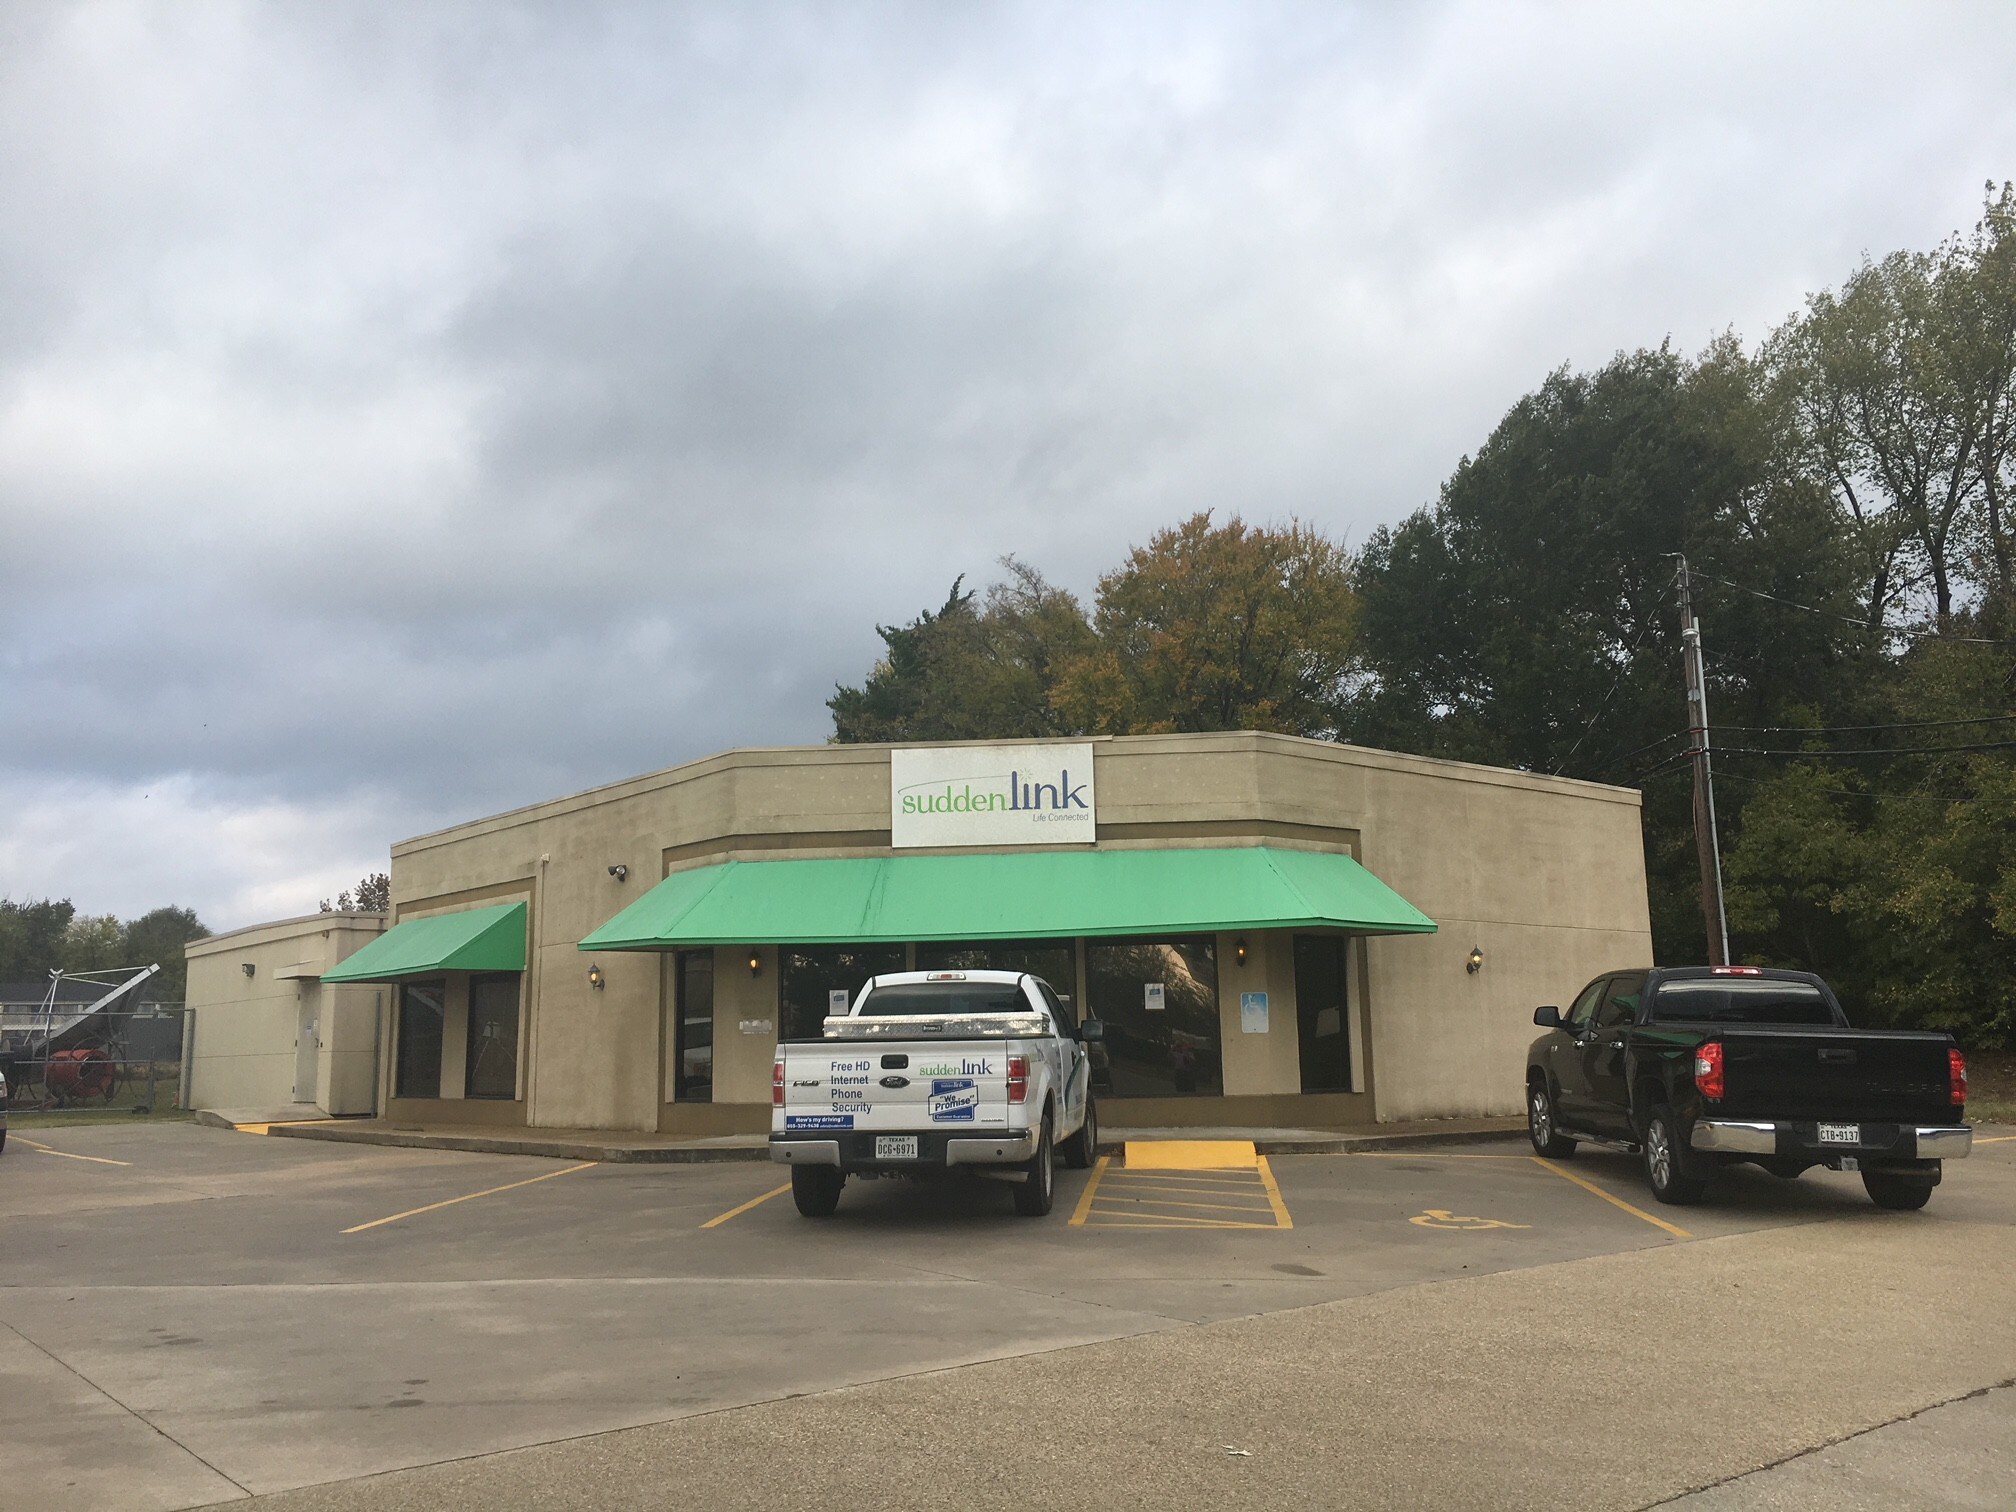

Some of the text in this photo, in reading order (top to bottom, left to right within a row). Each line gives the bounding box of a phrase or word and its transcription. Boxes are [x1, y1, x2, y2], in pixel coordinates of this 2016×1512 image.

[902, 769, 1089, 815] suddenlink
[1032, 813, 1089, 822] Life Connected
[831, 1060, 871, 1072] Free HD
[920, 1058, 992, 1076] suddenlink
[831, 1075, 869, 1085] Internet
[831, 1088, 863, 1099] Phone
[832, 1102, 872, 1115] Security
